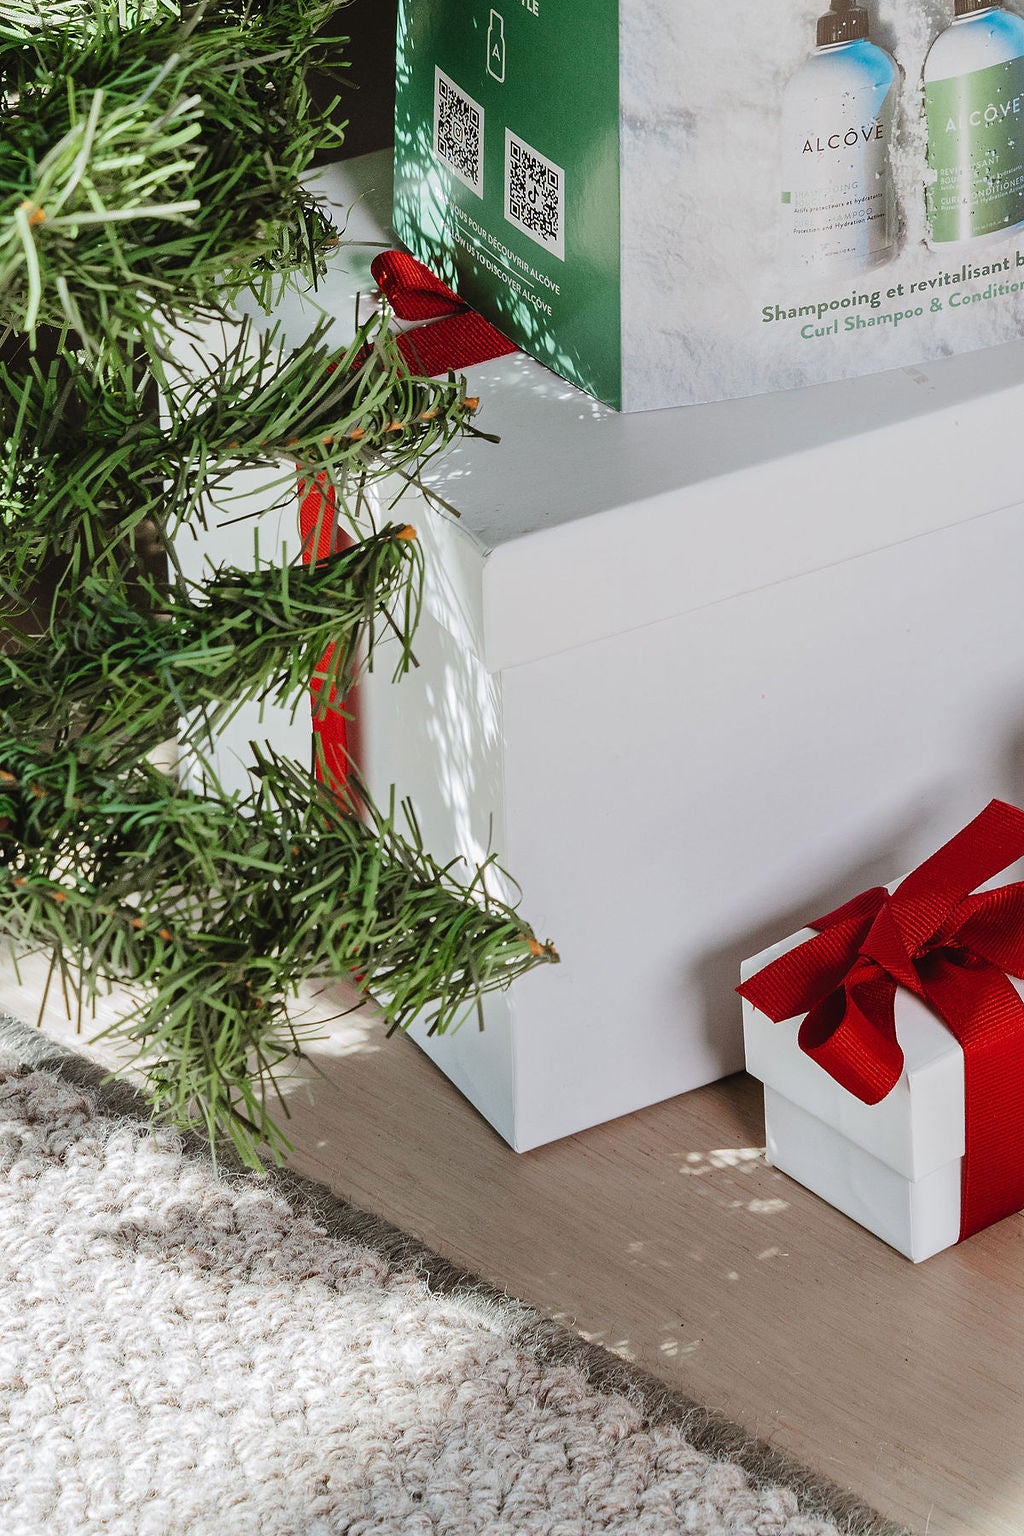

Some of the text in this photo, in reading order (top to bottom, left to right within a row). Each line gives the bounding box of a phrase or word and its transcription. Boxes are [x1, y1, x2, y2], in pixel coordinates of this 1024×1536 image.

[802, 124, 884, 154] ALCÔVE
[940, 155, 1000, 177] REVISANT
[971, 175, 1024, 200] ONDITIONER
[440, 218, 552, 316] OLOW US TO DISCOVER ALCÔVE
[468, 216, 487, 240] POUR
[488, 233, 531, 274] DÉCOUVRIR
[530, 268, 560, 296] ALCÔVE
[761, 290, 880, 323] Shampooing
[886, 283, 904, 300] et
[910, 256, 1010, 294] revitalisant
[800, 318, 838, 340] Curl
[843, 305, 923, 333] Shampoo
[929, 297, 943, 313] &
